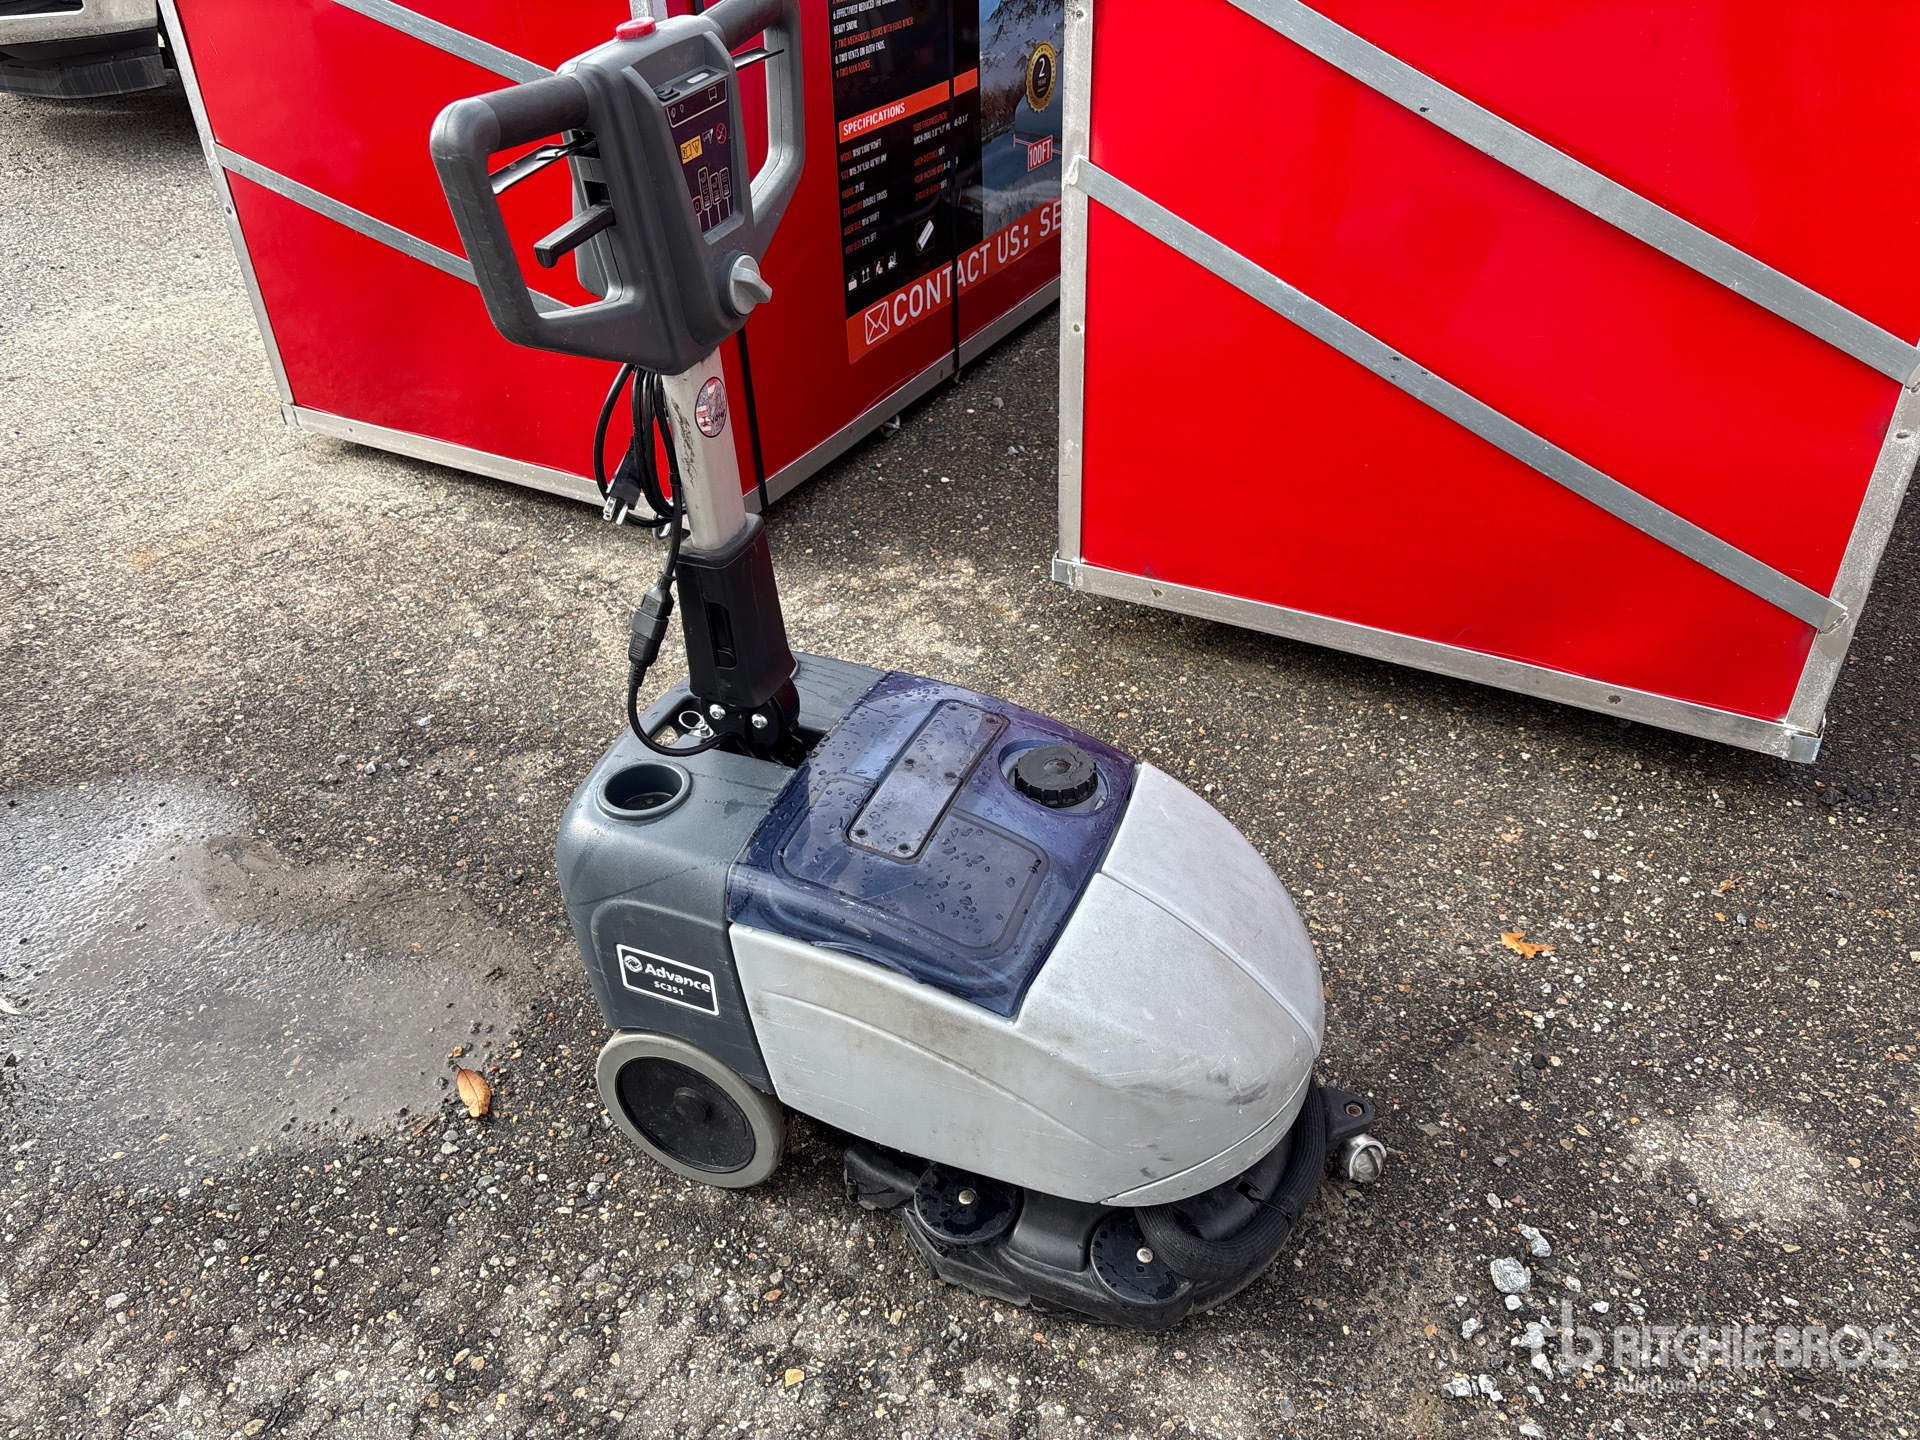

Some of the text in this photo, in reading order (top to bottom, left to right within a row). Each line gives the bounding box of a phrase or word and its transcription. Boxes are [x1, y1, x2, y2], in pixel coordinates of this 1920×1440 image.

[1039, 58, 1045, 77] 2
[843, 102, 905, 136] SPECIFICATIONS
[1029, 140, 1051, 167] 100FT
[893, 243, 990, 326] CONTACT
[997, 225, 1029, 264] US:
[645, 963, 710, 993] Advance
[654, 981, 684, 995] SC351
